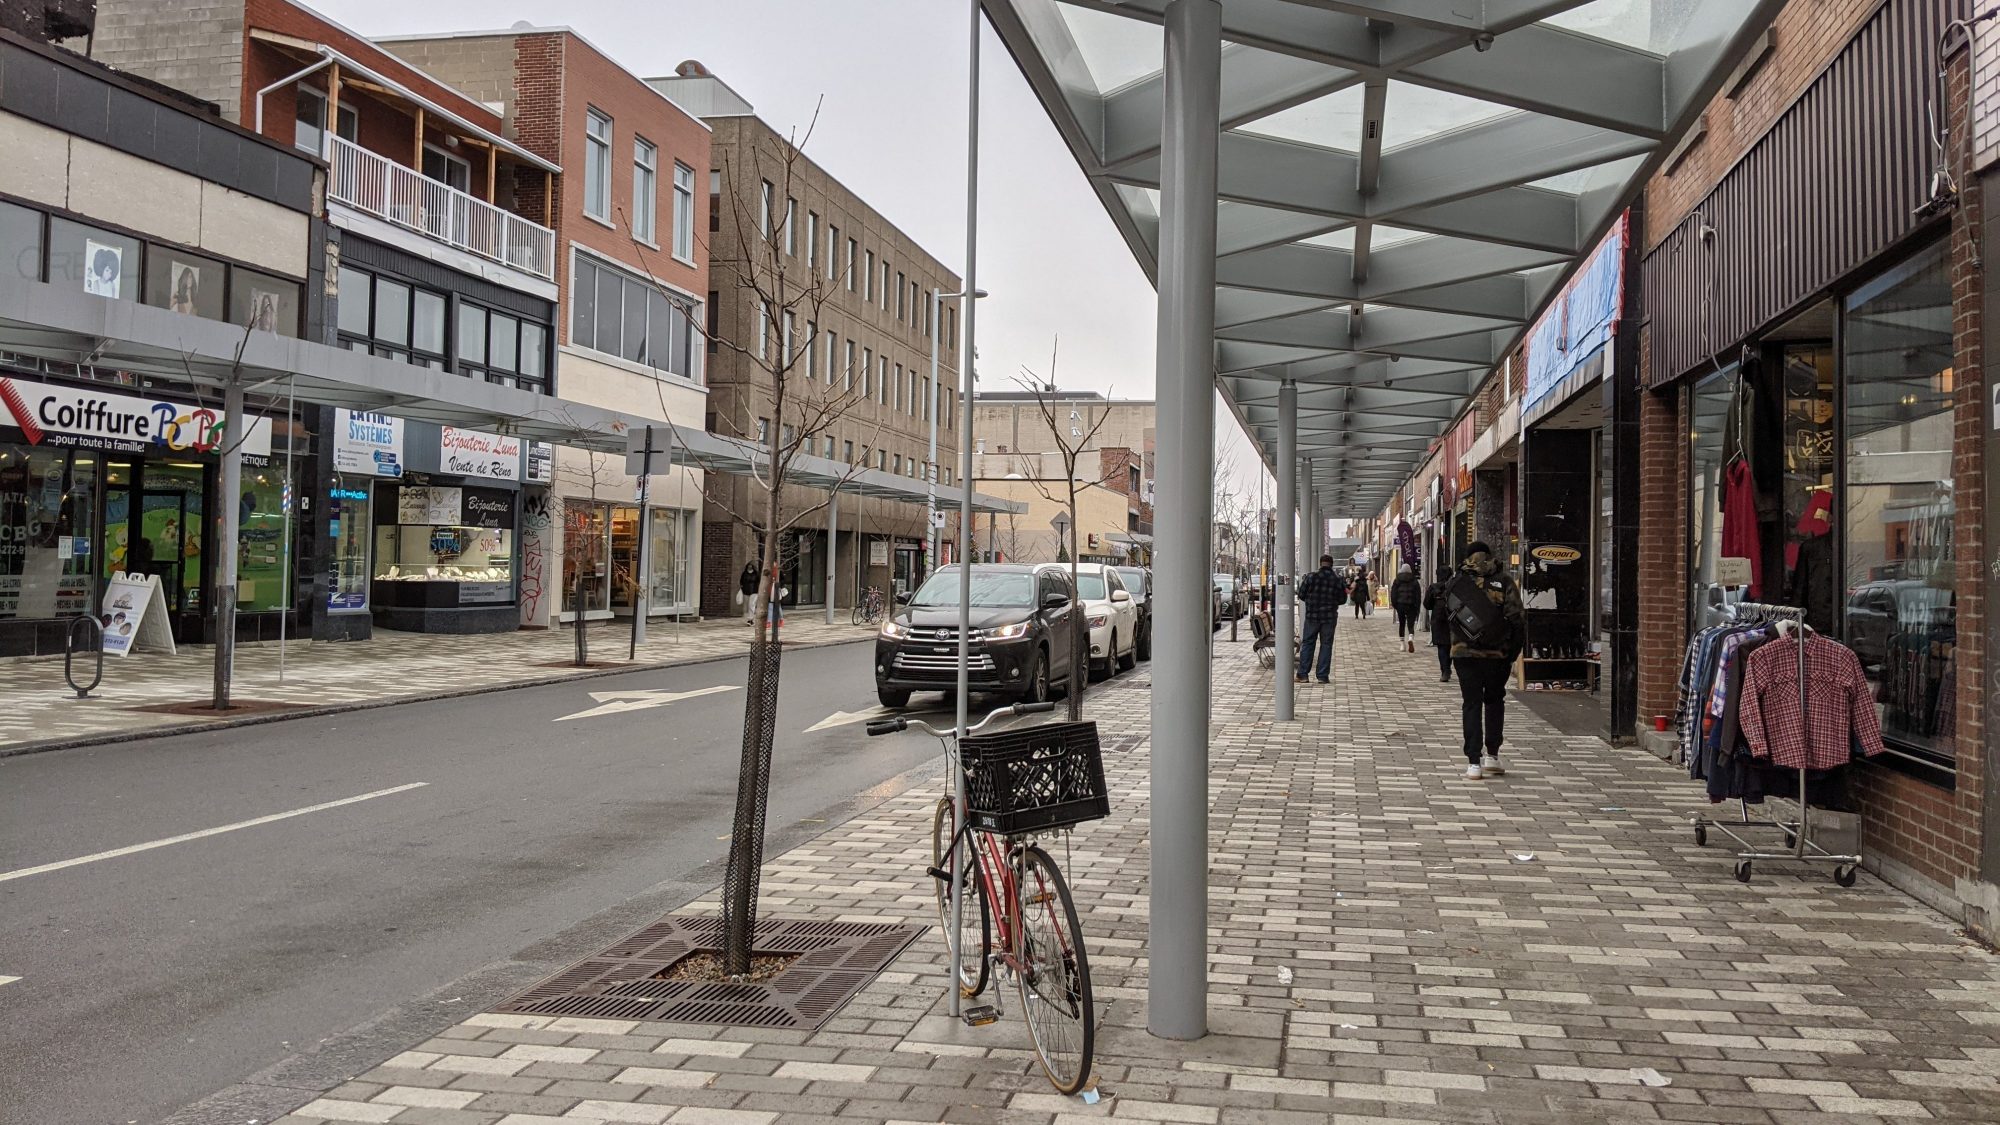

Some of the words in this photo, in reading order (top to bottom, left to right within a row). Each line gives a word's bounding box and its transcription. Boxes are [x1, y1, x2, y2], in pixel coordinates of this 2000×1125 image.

[39, 396, 149, 438] Coiffure
[349, 420, 393, 445] SYSTÈMES
[443, 426, 490, 455] Bijouterie
[493, 435, 519, 457] Luna
[79, 437, 103, 449] toute
[104, 439, 113, 449] la
[113, 440, 145, 453] famille!
[448, 456, 474, 473] Vente
[476, 460, 488, 474] de
[490, 461, 512, 477] Réno
[468, 495, 508, 514] Bijouterie
[477, 512, 499, 528] Luna
[479, 538, 496, 552] 50%
[1538, 549, 1575, 558] Grisport
